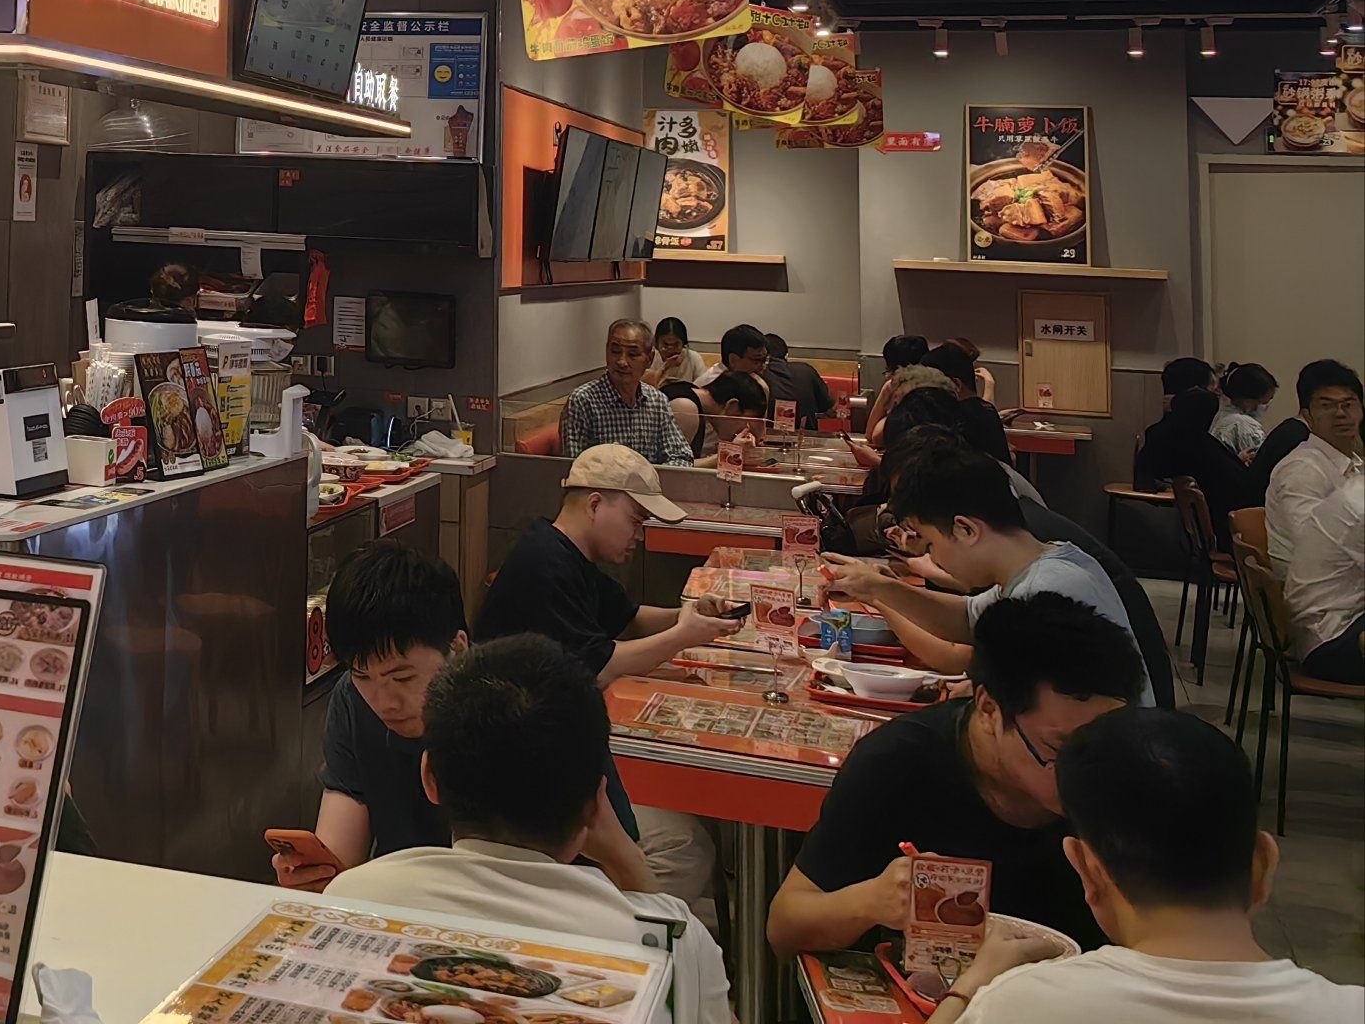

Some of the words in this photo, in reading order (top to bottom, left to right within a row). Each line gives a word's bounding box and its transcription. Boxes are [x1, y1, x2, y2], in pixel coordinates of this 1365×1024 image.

[973, 116, 1083, 134] 牛腩萝卜饭
[1040, 323, 1088, 337] 水闸开关
